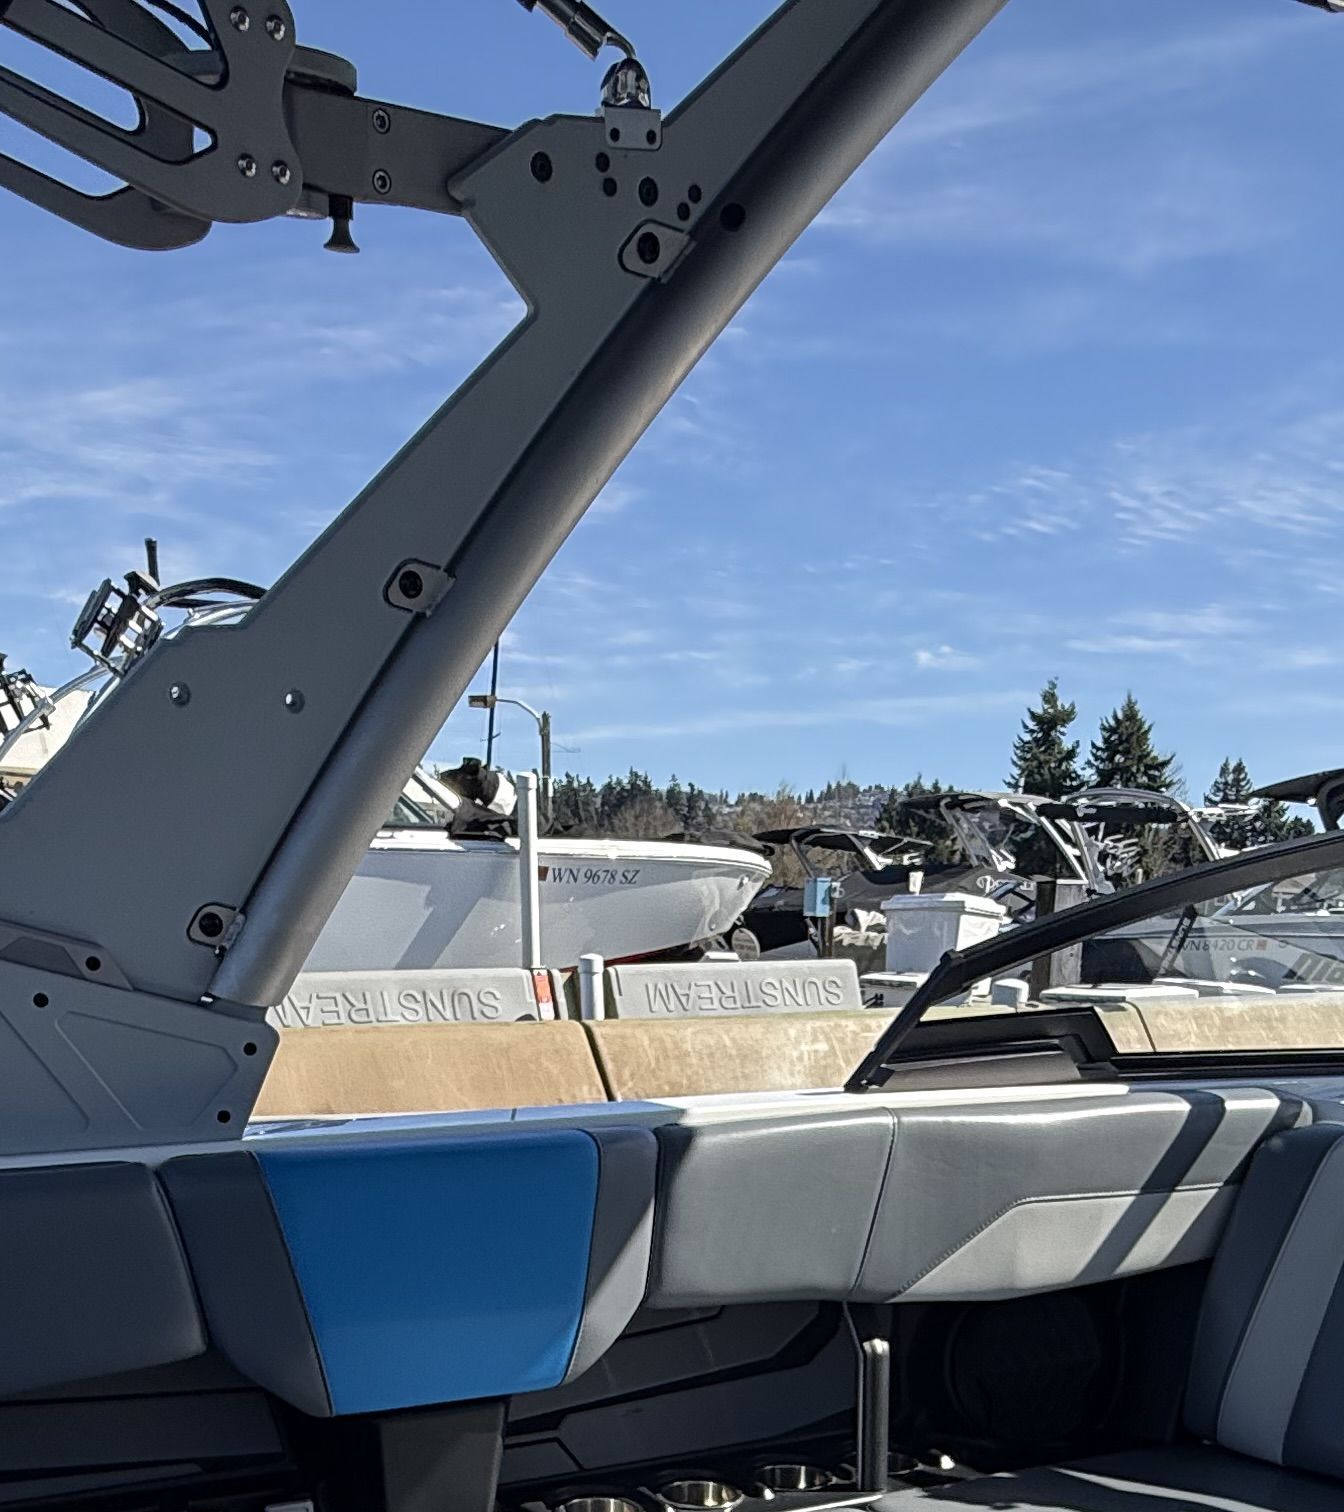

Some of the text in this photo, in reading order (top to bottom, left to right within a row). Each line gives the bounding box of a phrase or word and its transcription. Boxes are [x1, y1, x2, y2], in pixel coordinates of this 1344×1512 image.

[551, 867, 641, 885] WN 9678 SZ
[645, 976, 843, 1013] SUNSTREAM
